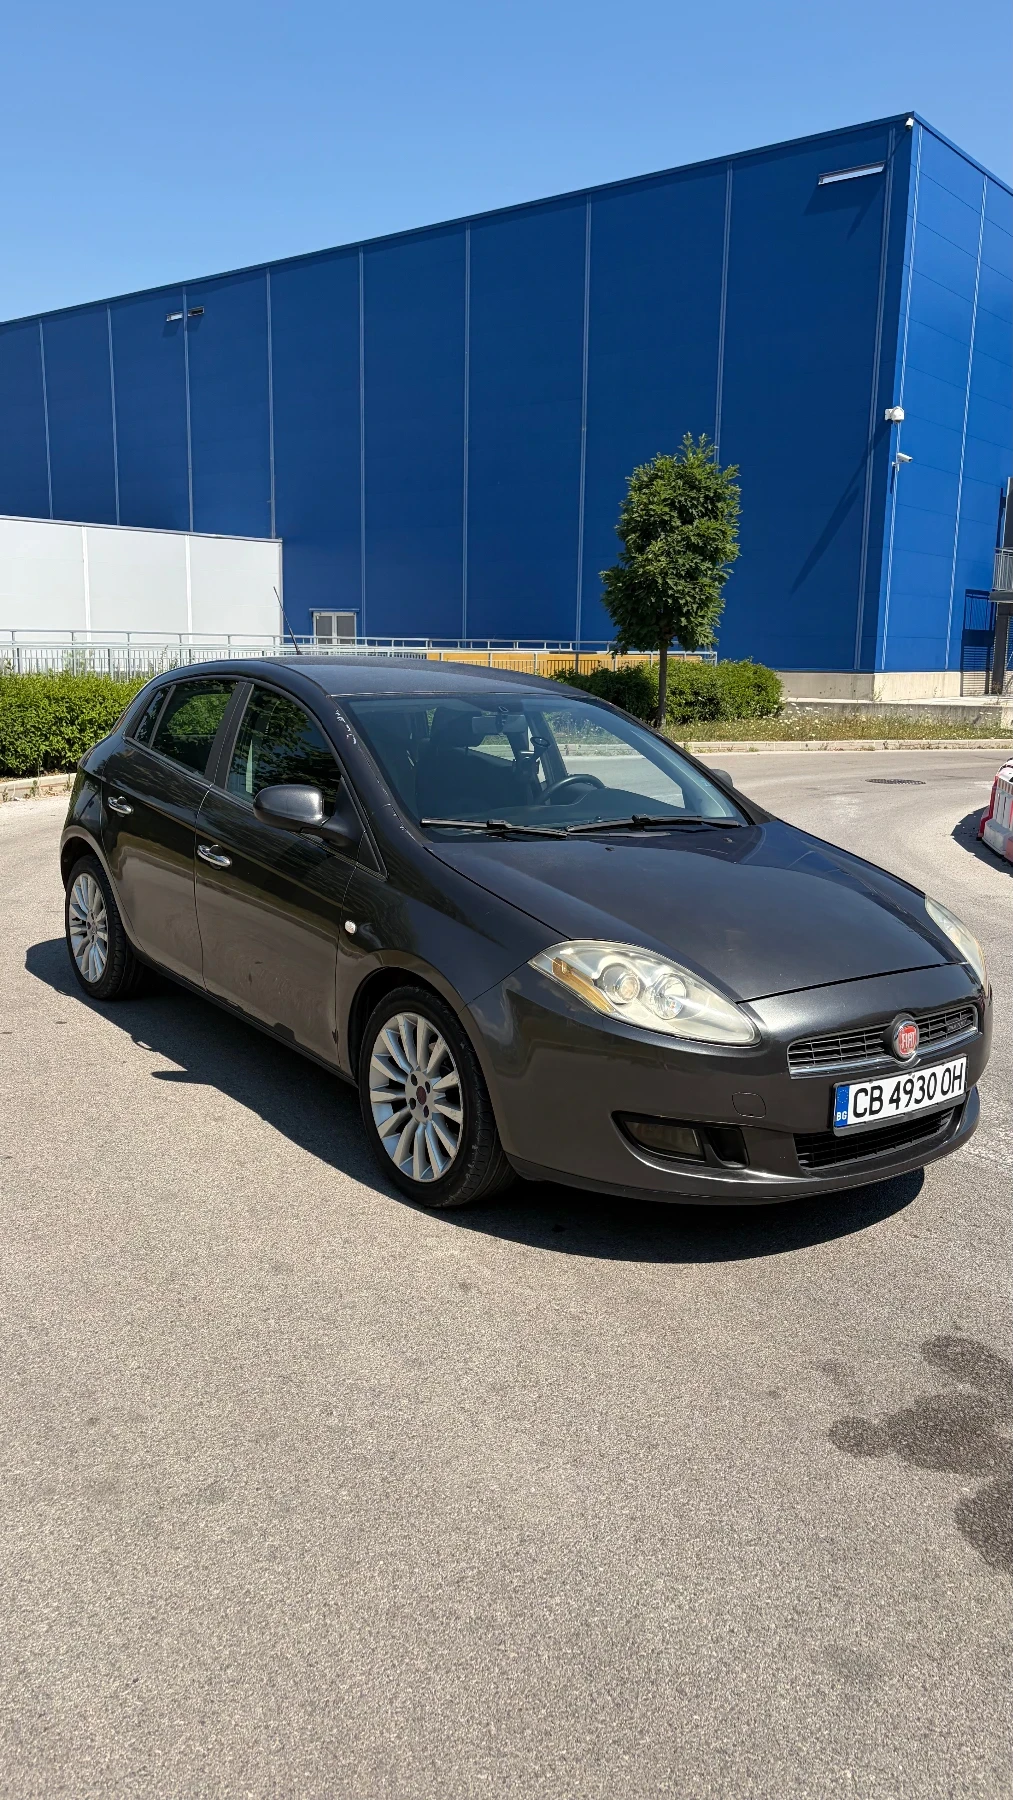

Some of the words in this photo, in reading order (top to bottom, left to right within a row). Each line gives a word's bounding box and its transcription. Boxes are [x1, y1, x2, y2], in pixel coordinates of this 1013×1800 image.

[901, 1031, 916, 1049] FIAT
[853, 1085, 883, 1118] CB
[888, 1072, 937, 1110] 4930
[941, 1063, 964, 1096] OH
[836, 1111, 847, 1121] BG
